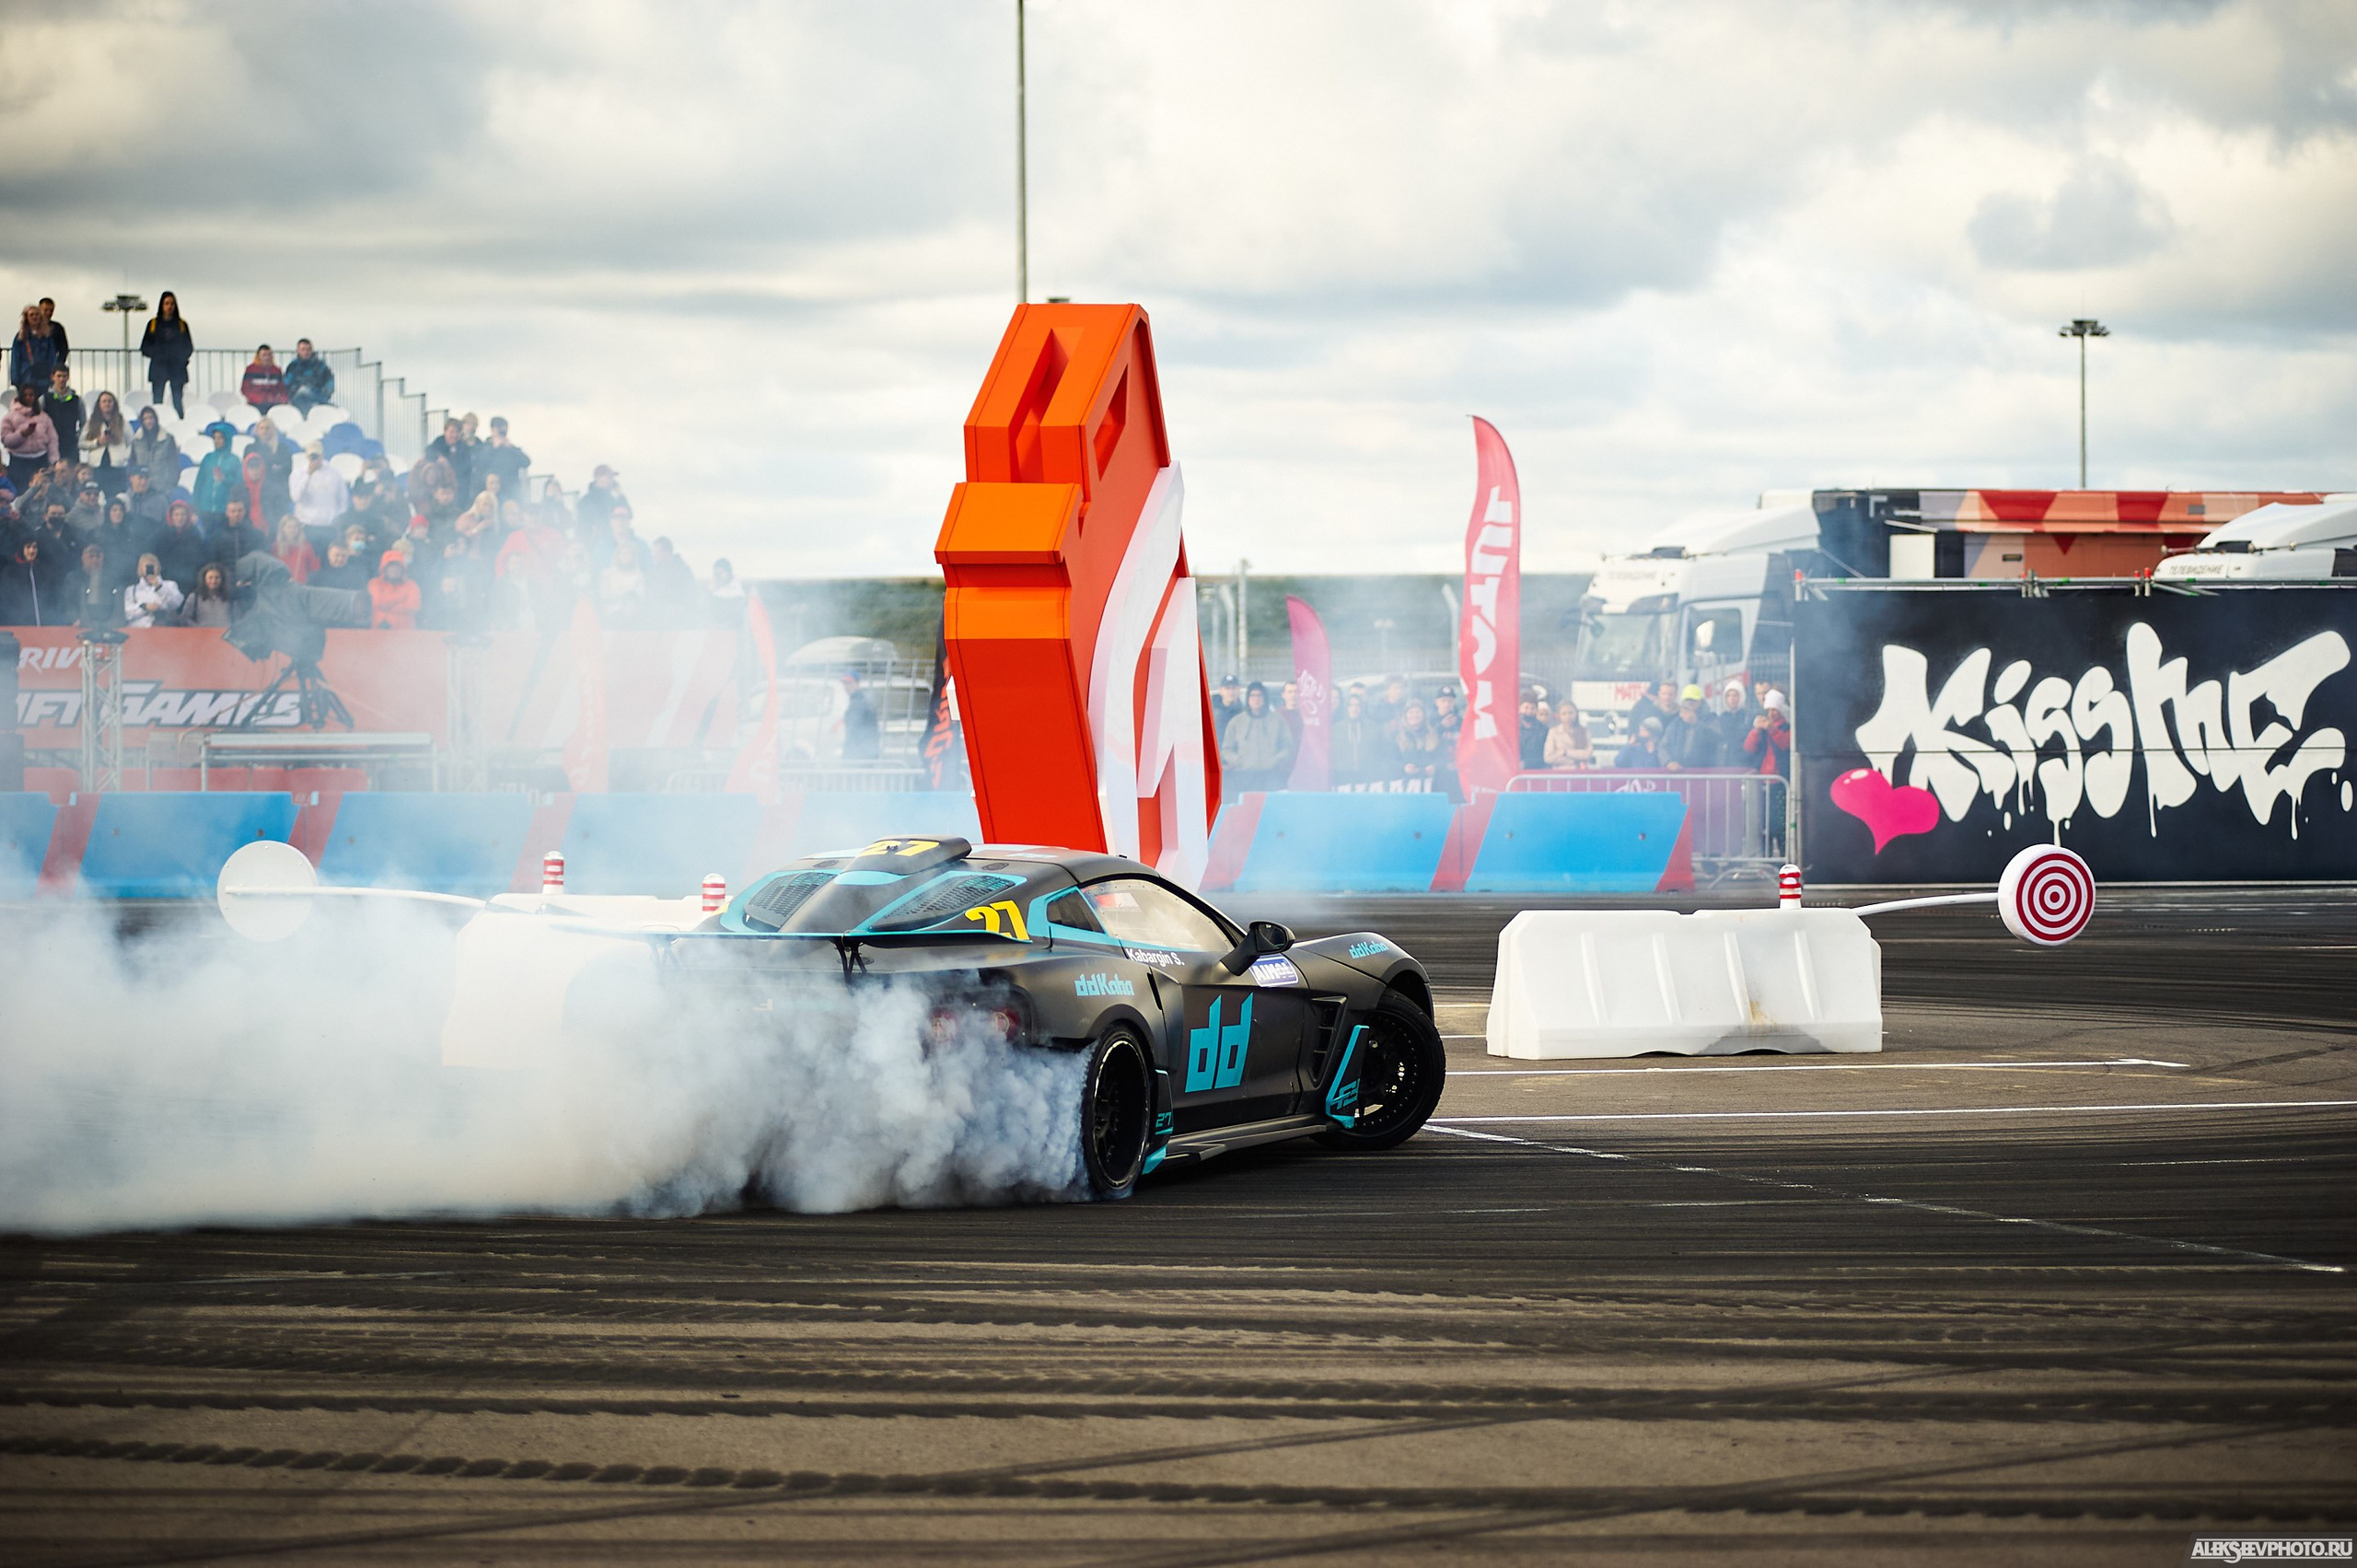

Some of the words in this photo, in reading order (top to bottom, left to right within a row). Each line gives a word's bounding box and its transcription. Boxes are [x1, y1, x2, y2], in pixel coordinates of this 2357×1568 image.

[861, 840, 940, 857] 27
[964, 900, 1030, 940] 27
[1124, 947, 1174, 967] Kabargin
[1170, 951, 1185, 966] S.
[1074, 972, 1135, 996] ddKaba
[1185, 992, 1254, 1093] dd
[1155, 1111, 1172, 1128] 27
